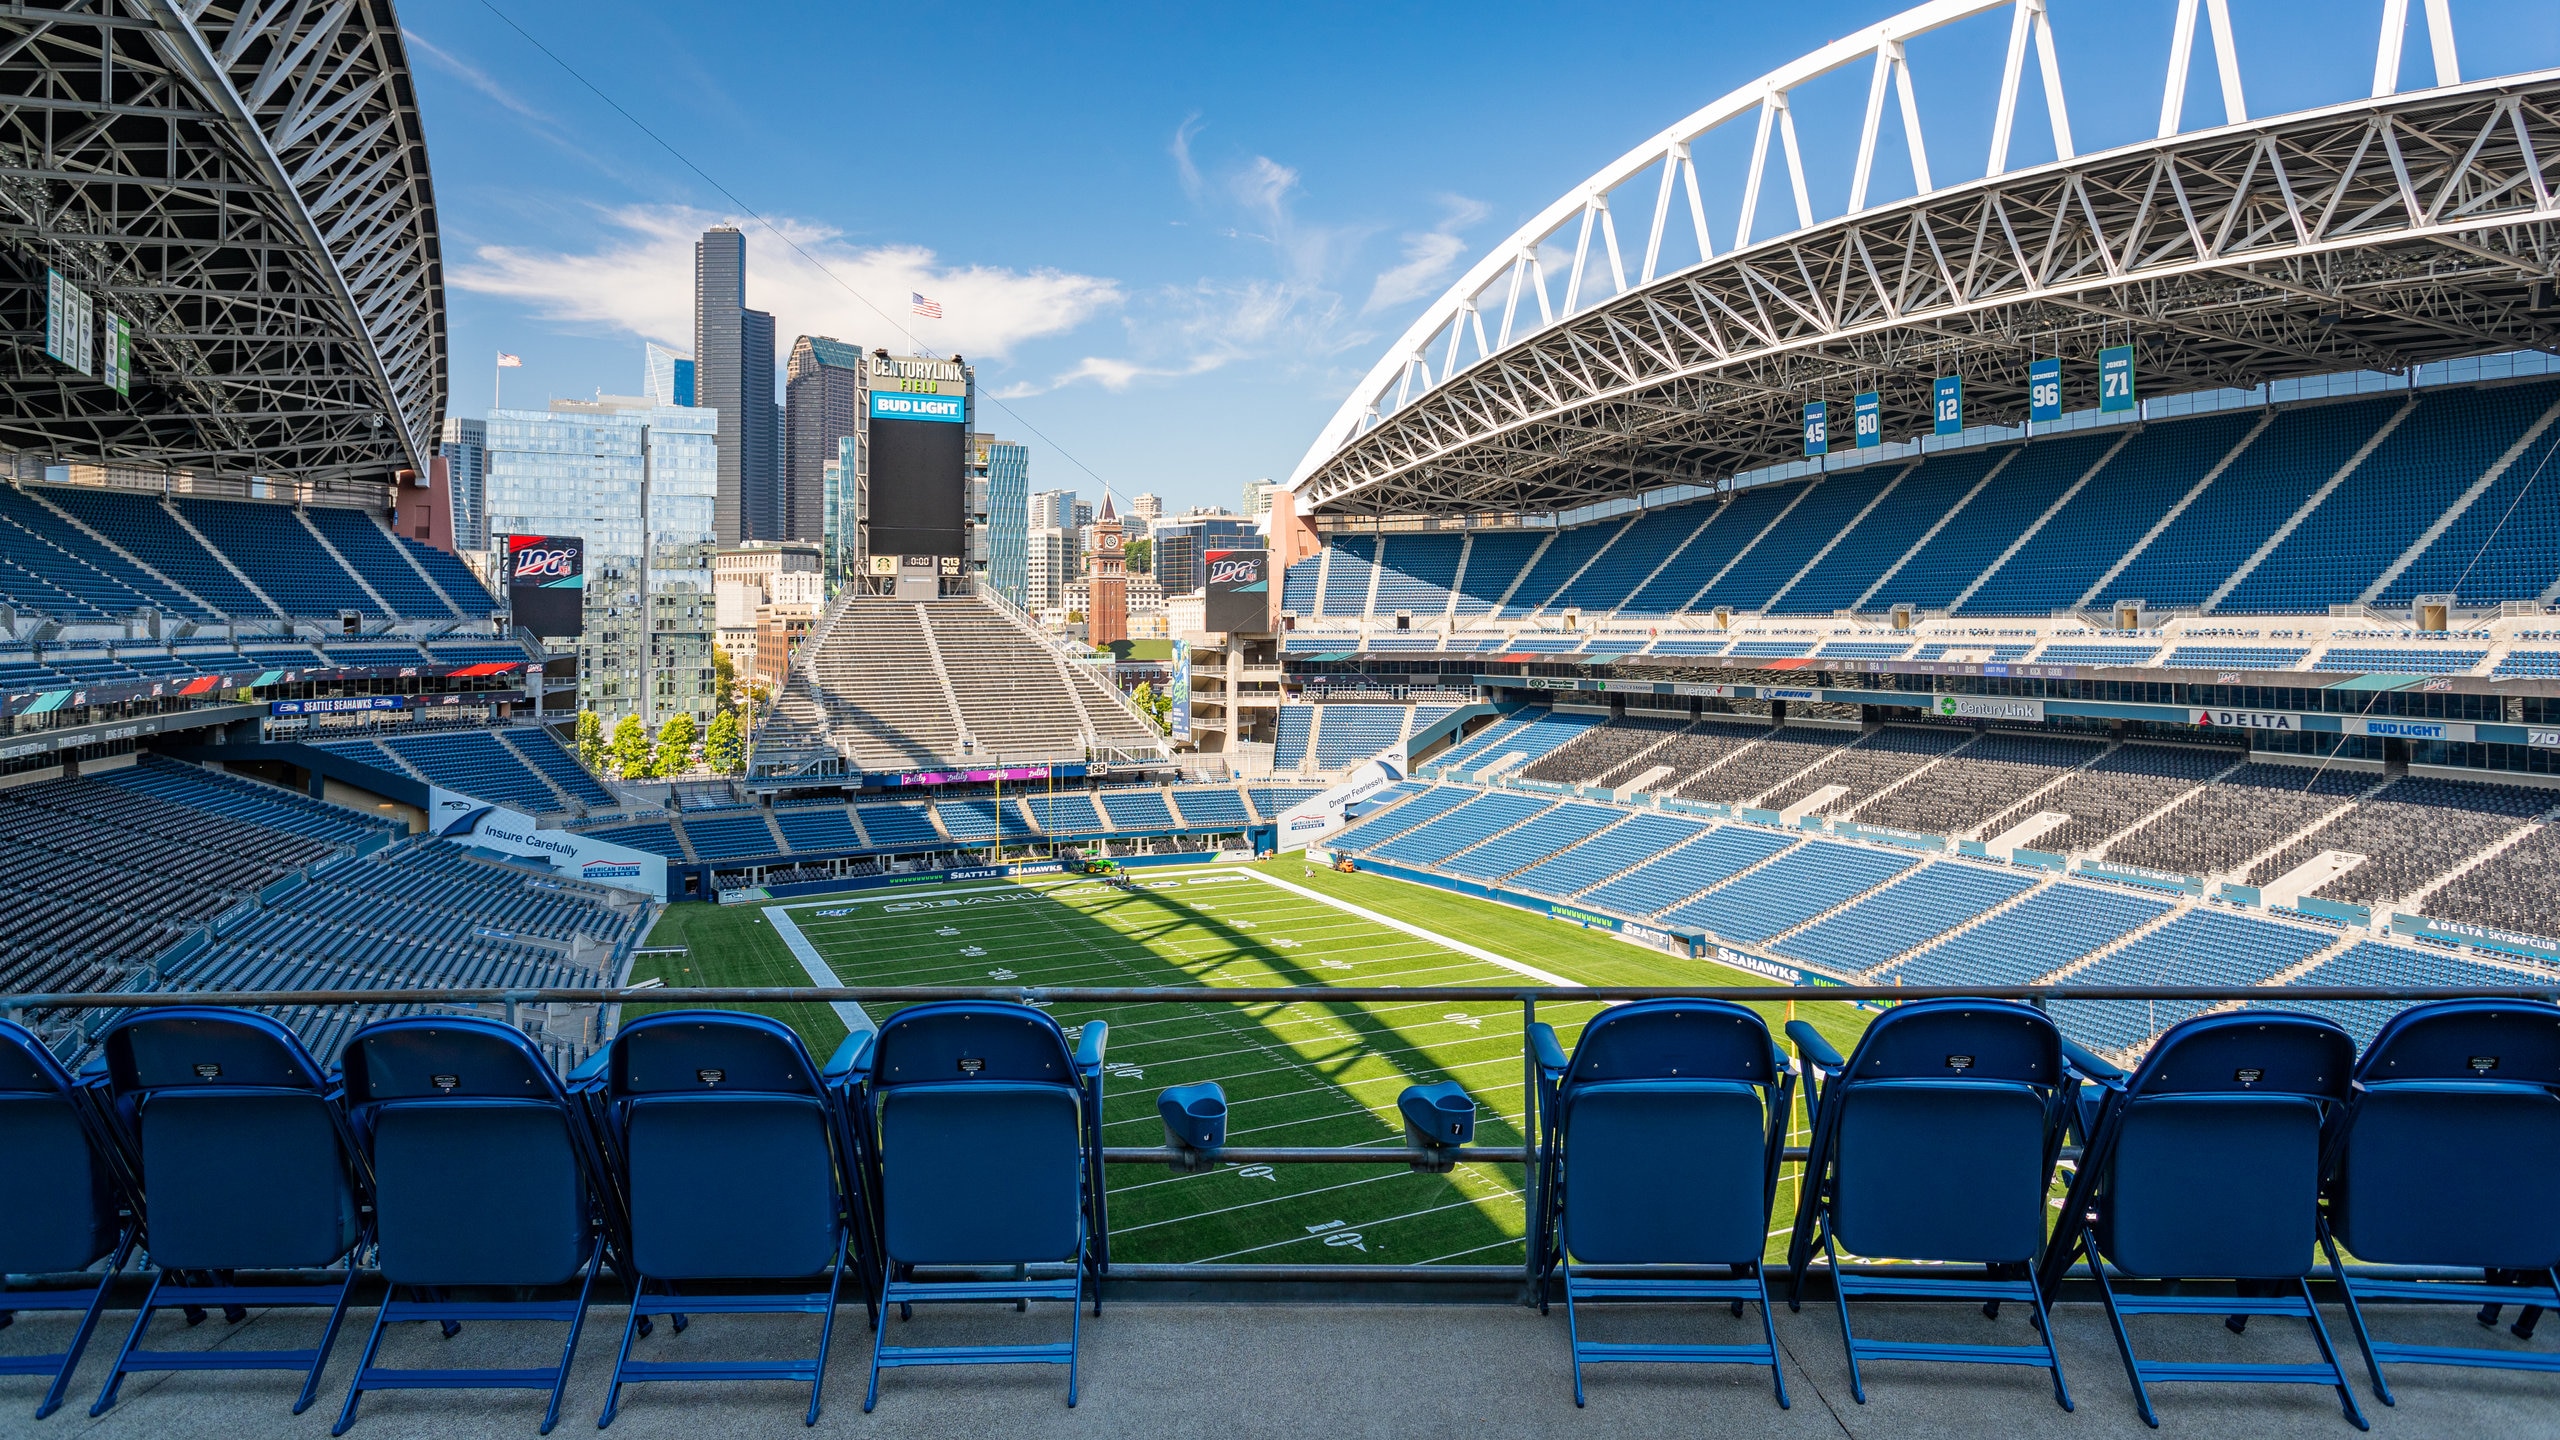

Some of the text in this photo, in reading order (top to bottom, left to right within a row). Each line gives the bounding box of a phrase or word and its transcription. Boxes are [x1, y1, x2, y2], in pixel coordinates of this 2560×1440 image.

[2105, 360, 2127, 369] JONES
[2032, 371, 2058, 380] KENNEDY
[900, 378, 937, 393] FIELD
[1940, 388, 1954, 396] FAN
[2104, 372, 2128, 397] 71
[2032, 383, 2058, 408] 96
[878, 398, 958, 414] BUD LIGHT
[1856, 402, 1878, 412] LARGENT
[1938, 398, 1958, 421] 12
[1858, 413, 1877, 435] 80
[1806, 422, 1824, 443] 45
[514, 549, 565, 576] 100
[910, 557, 930, 566] 0:00
[941, 557, 960, 566] Q13
[942, 566, 959, 574] FOX
[1210, 561, 1251, 584] 100
[1870, 662, 1880, 670] SEA
[1684, 686, 1718, 697] verizon
[1774, 690, 1812, 698] BOEING
[304, 698, 372, 712] SEATTLE SEAHAWKS
[1960, 700, 2034, 718] CenturyLink
[2220, 712, 2290, 729] DELTA
[2368, 722, 2442, 738] BUD LIGHT
[1092, 764, 1105, 773] 25
[1328, 776, 1384, 808] Dream Fearlessly
[1864, 826, 1885, 834] DELTA
[485, 825, 578, 858] Insure Carefully
[950, 864, 1063, 879] SEATTLE SEAHAWKS
[2107, 864, 2136, 875] DELTA
[2166, 874, 2185, 884] CLUB
[2440, 922, 2484, 937] DELTA
[2530, 938, 2557, 950] CLUB
[1718, 948, 1801, 981] SEAHAWKS
[1455, 1124, 1460, 1134] 7
[1305, 1220, 1362, 1246] 10
